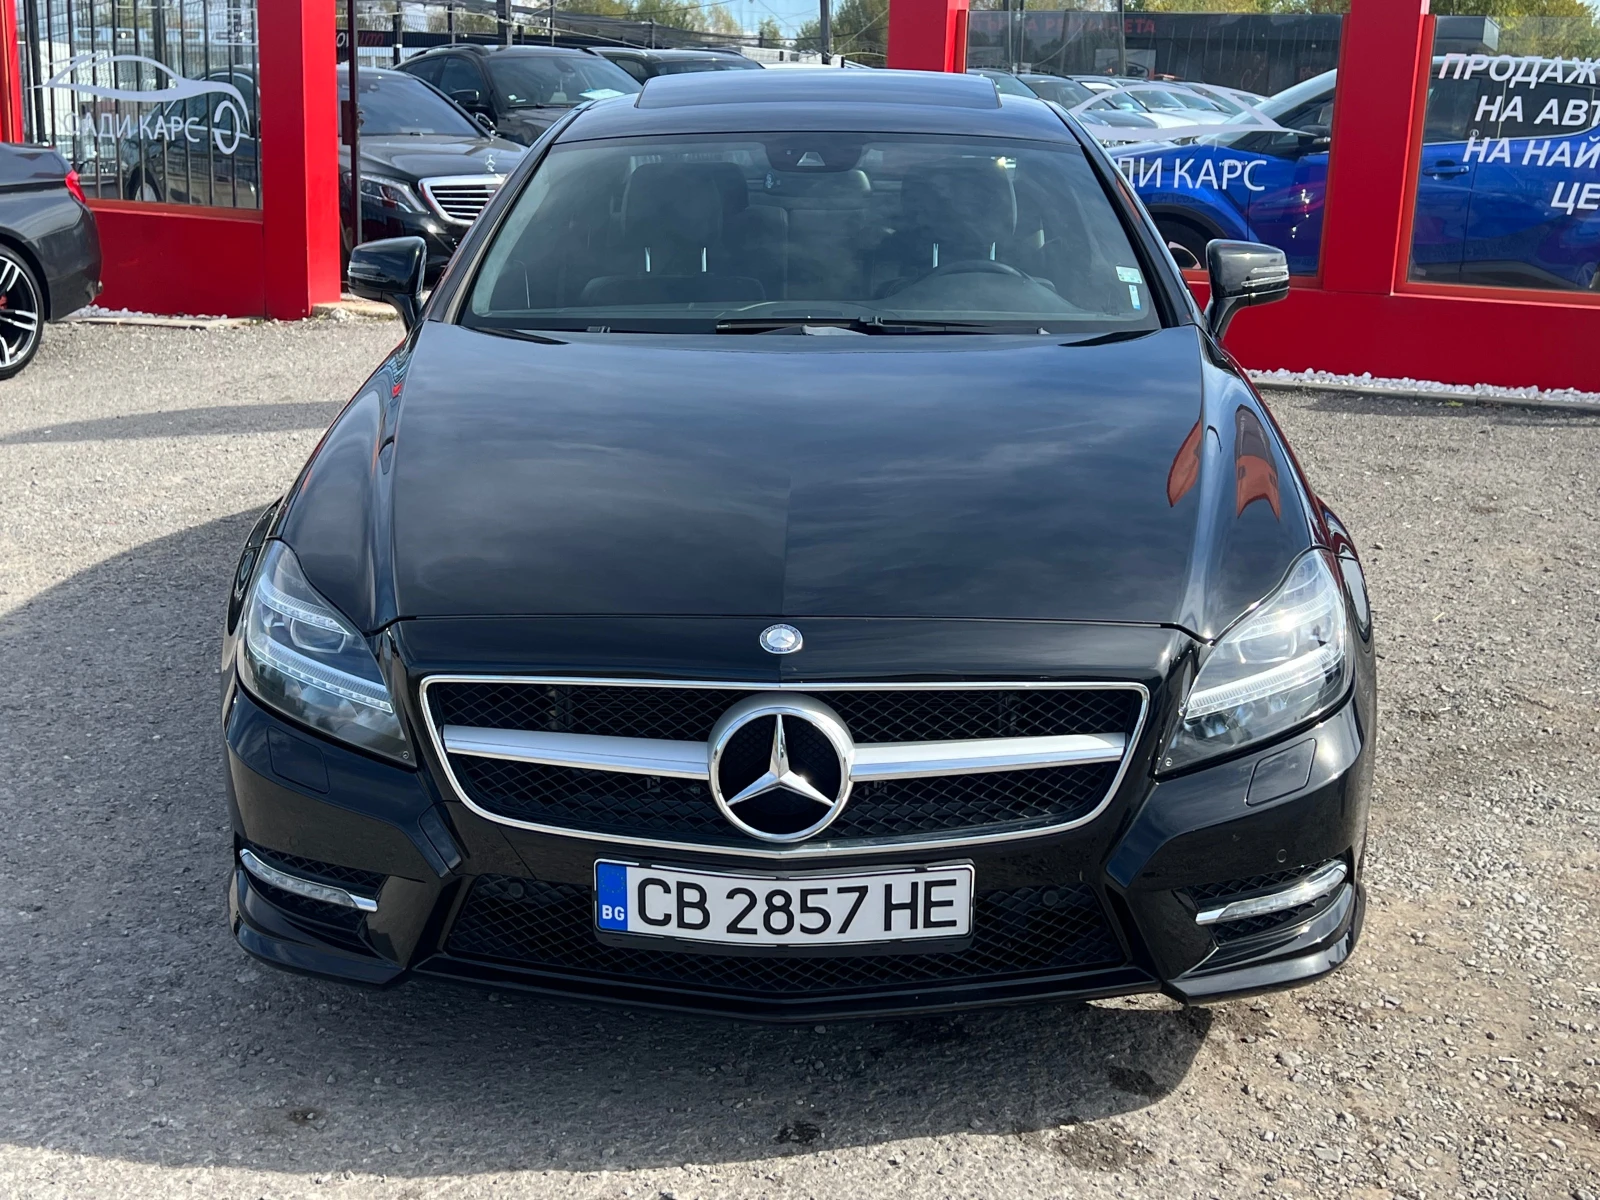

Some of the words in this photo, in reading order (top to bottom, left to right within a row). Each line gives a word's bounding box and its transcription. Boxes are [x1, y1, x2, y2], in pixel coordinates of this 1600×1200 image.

[1438, 53, 1600, 89] ПРОДАЖ
[1474, 95, 1523, 122] НА
[64, 111, 131, 142] САДИ
[139, 114, 200, 142] КАРС
[1462, 136, 1511, 163] НА
[1522, 135, 1600, 168] НАЙ
[1117, 157, 1163, 189] ДИ
[1173, 158, 1267, 191] КАРС
[1551, 181, 1600, 215] ЦЕ
[602, 904, 625, 921] BG
[637, 877, 710, 929] CB
[725, 885, 869, 935] 2857
[883, 879, 957, 932] HE
